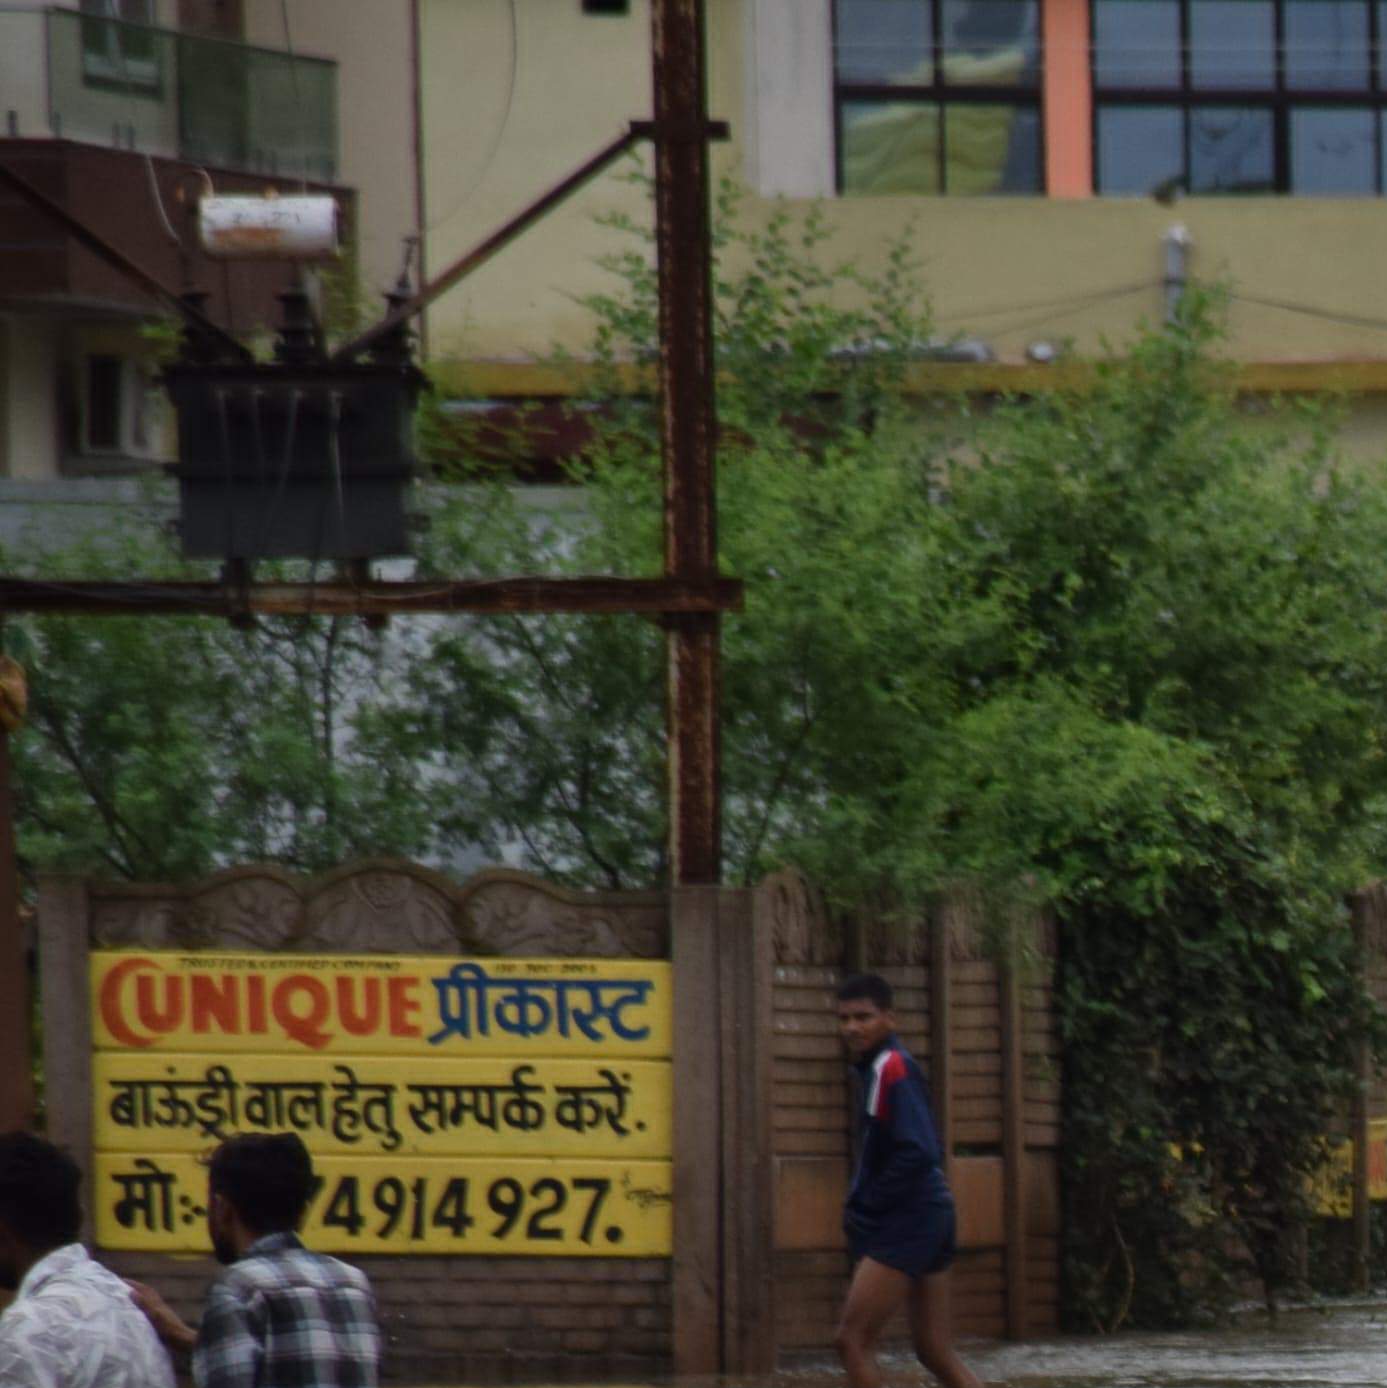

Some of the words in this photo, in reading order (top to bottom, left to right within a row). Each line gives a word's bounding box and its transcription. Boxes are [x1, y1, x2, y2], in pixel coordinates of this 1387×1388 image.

[427, 962, 656, 1043] प्रीकास्ट
[245, 1081, 326, 1131] वाल
[332, 1065, 403, 1151] हेतु
[406, 1065, 546, 1135] सम्पर्क
